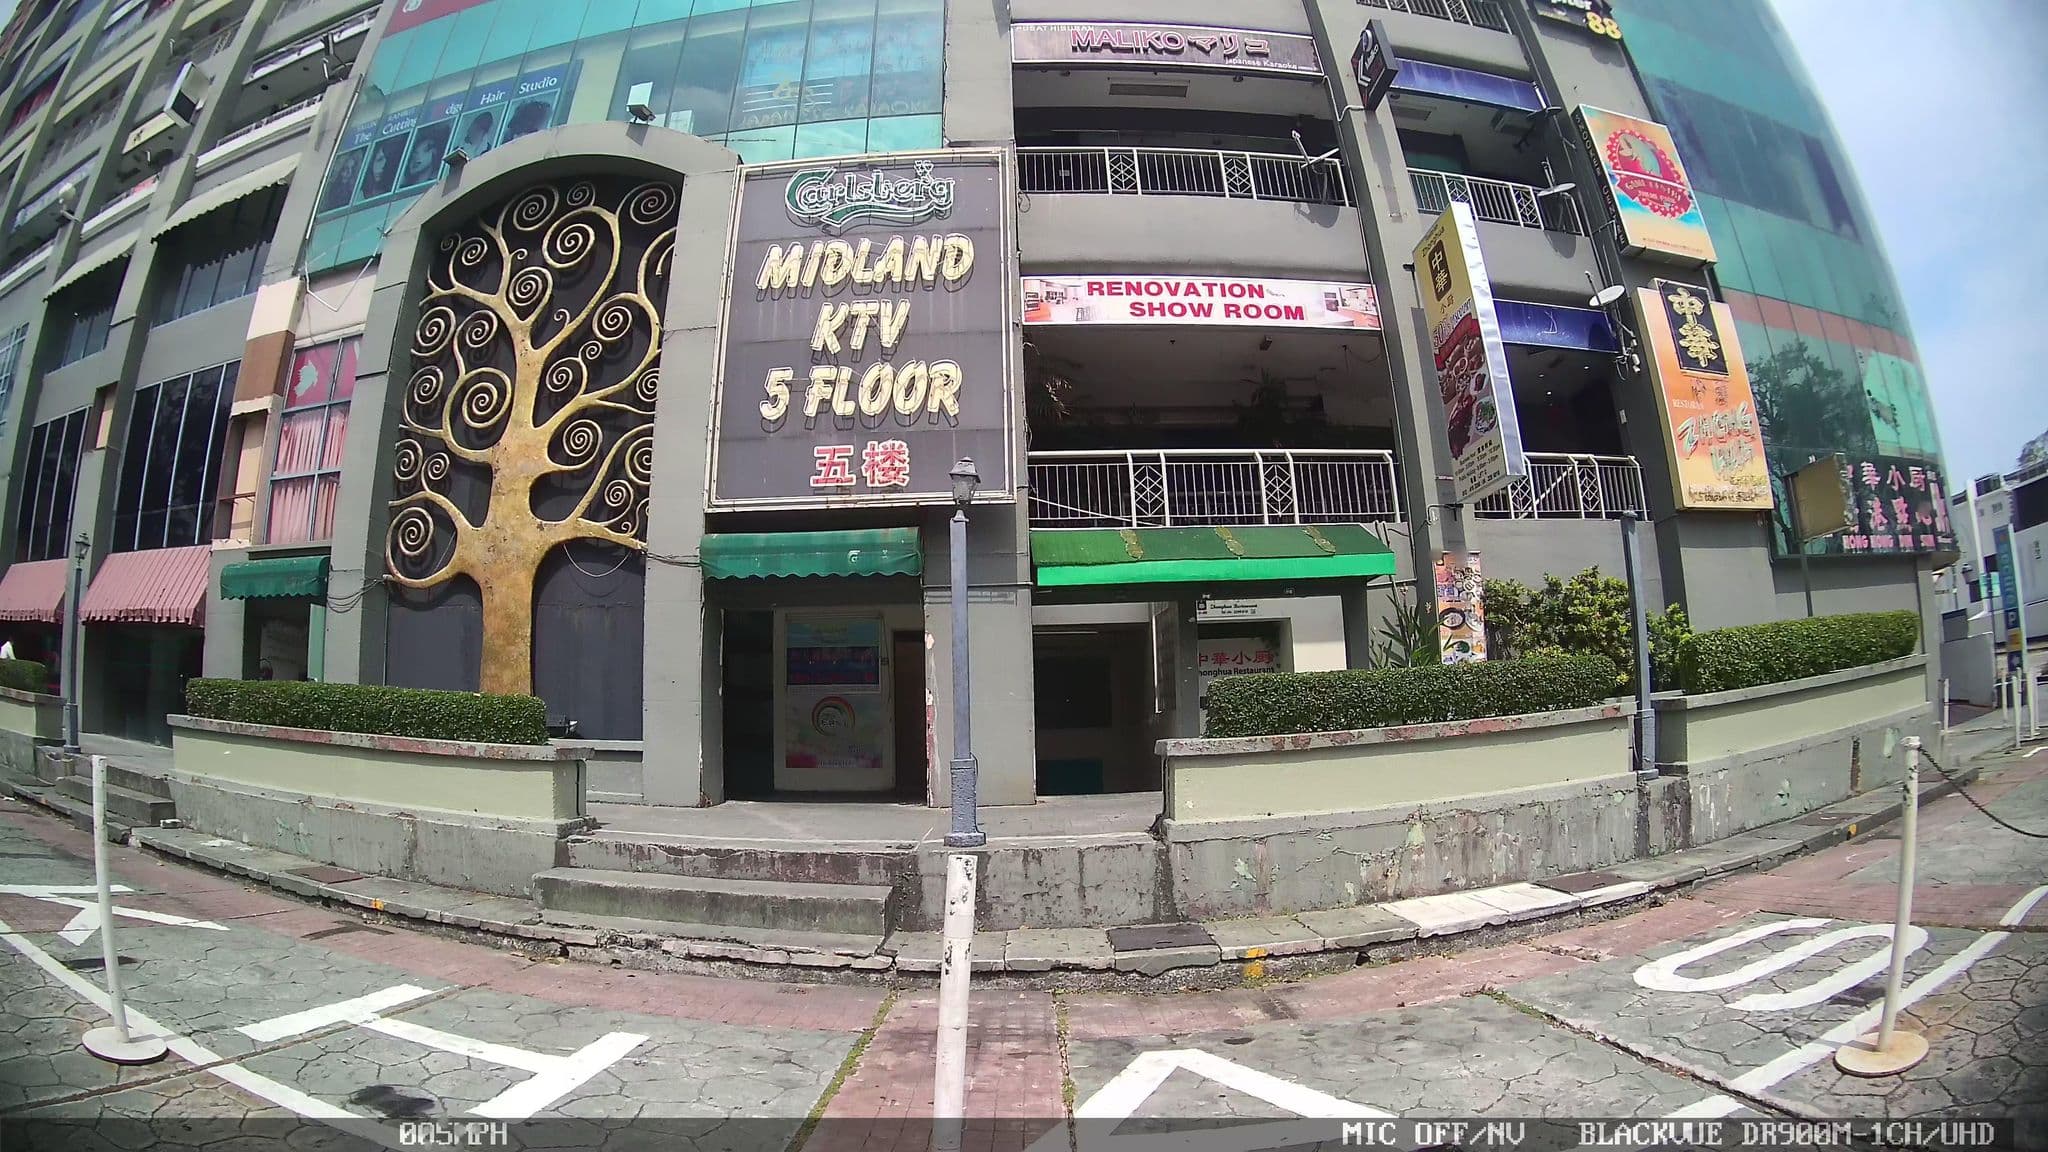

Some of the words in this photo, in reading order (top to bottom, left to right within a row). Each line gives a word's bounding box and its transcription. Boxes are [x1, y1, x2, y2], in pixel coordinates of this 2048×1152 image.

[1071, 27, 1184, 49] MALIKO
[1586, 11, 1622, 39] 88
[480, 90, 506, 105] Hair
[519, 77, 558, 94] Studio
[785, 161, 955, 226] Carlsberg
[755, 233, 975, 291] MIDLAND
[1086, 280, 1266, 299] RENOVATION
[810, 298, 911, 355] KTV
[1129, 301, 1213, 318] SHOW
[1224, 303, 1305, 321] ROOM
[759, 366, 794, 421] 5
[803, 358, 963, 418] FLOOR
[809, 439, 911, 488] 五楼
